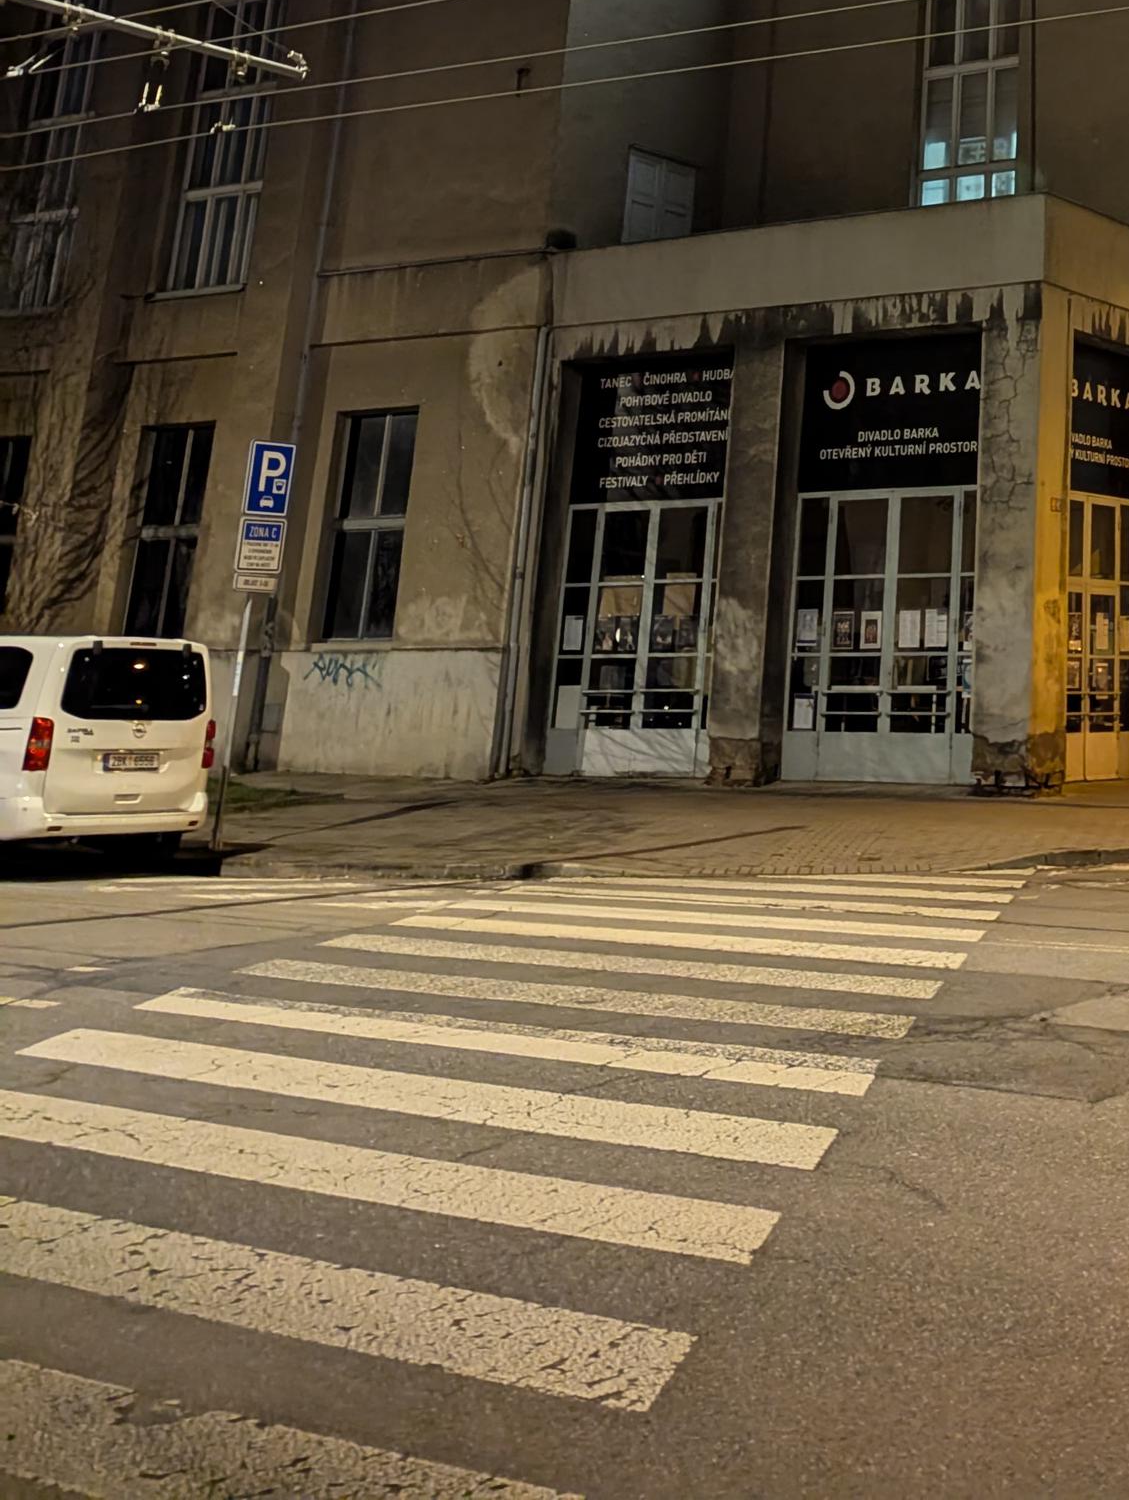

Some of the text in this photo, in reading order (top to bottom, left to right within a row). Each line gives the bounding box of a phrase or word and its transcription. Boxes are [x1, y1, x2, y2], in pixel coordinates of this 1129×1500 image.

[601, 376, 632, 388] TANEC
[643, 372, 687, 385] ČINOHRA
[865, 370, 981, 397] BARKA
[619, 390, 712, 407] POHYBOVÉ DIVADLO
[598, 407, 729, 428] CESTOVATELSKÁ PROMÍTÁN
[597, 431, 660, 448] CIZOJAZYČNÁ
[857, 427, 939, 443] DIVADLO BARKA
[615, 450, 707, 468] POHÁDKY PRO DĚTI
[819, 440, 977, 460] OTEVŘENÝ KULTURNÍ PROSTOR
[258, 450, 286, 492] P
[599, 470, 720, 488] FESTIVALY PŘEHLÍDKY
[271, 527, 278, 539] C
